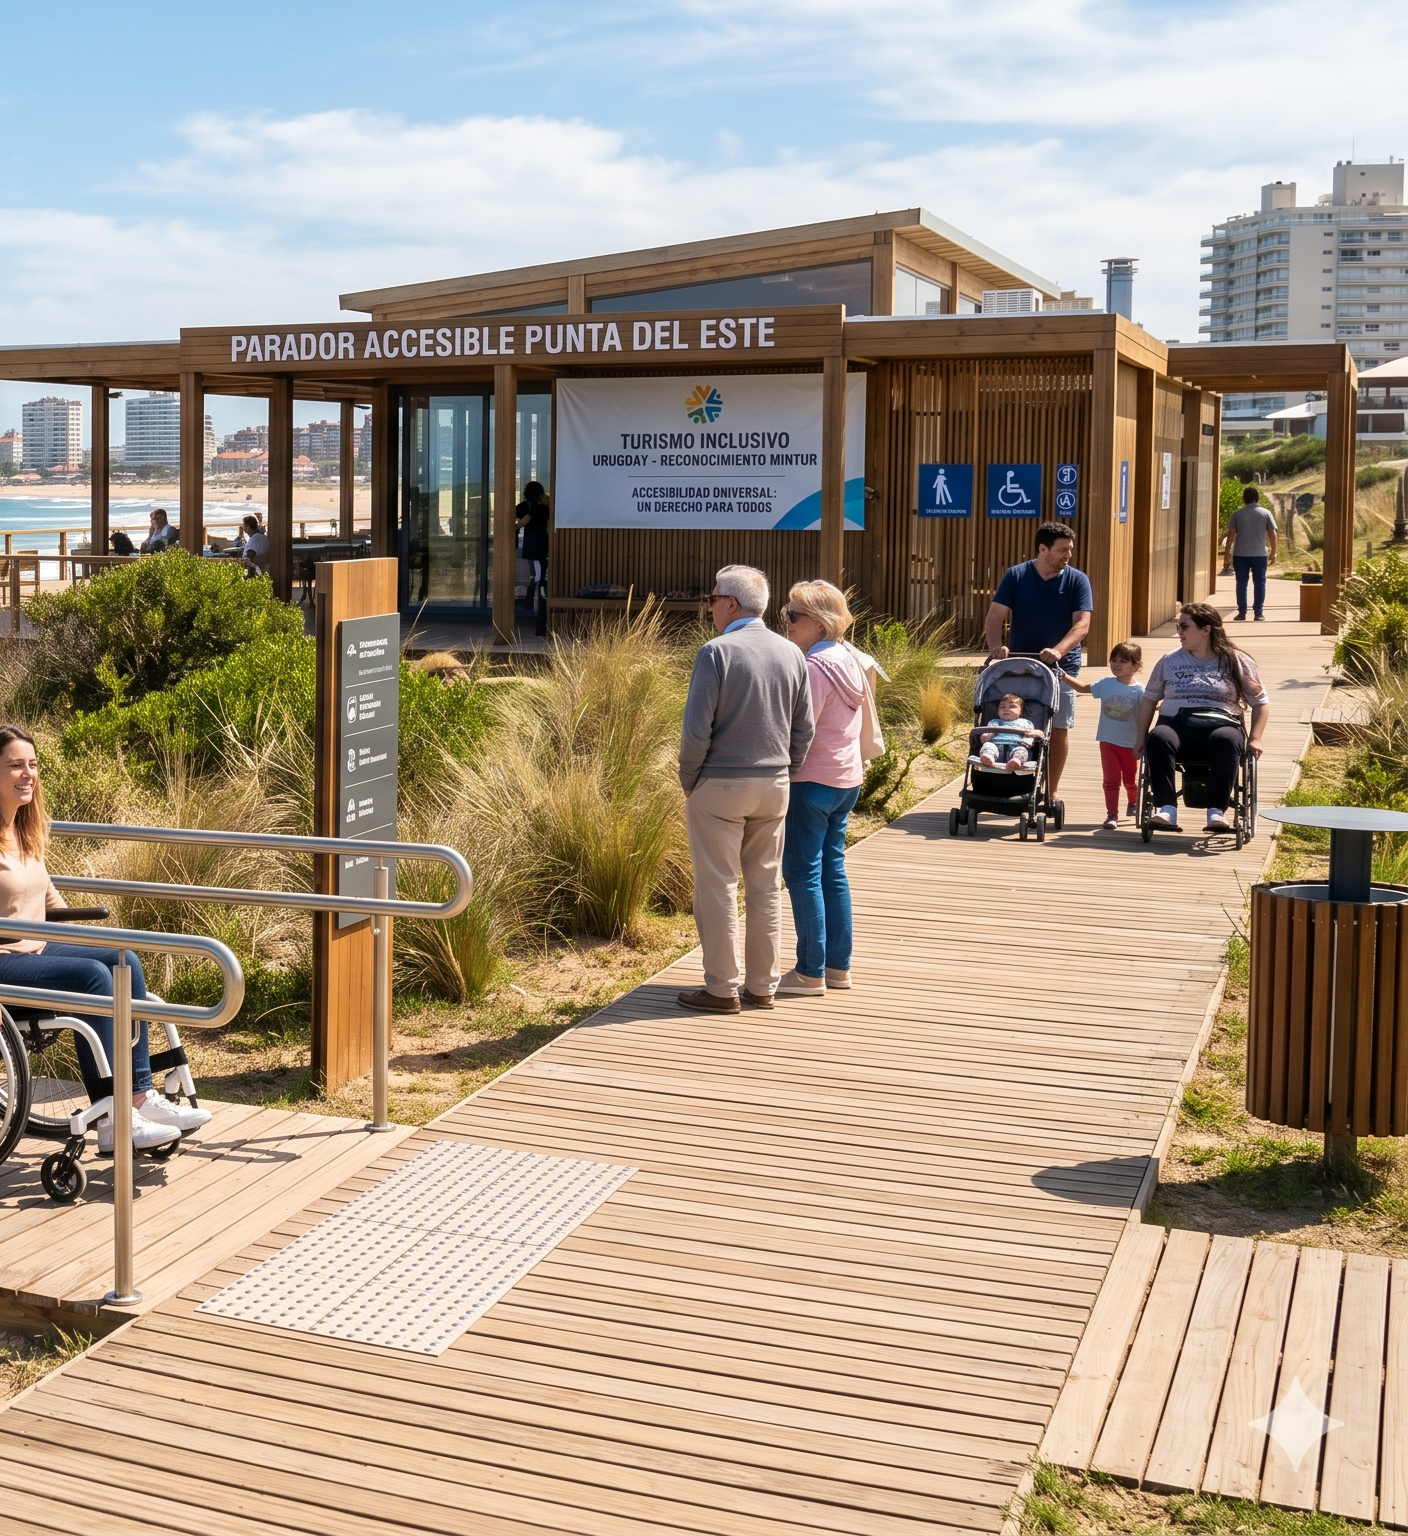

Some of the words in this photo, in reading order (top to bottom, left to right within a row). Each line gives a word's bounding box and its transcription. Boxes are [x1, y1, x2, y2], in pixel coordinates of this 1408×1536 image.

[231, 332, 355, 362] PARADOR
[363, 326, 515, 359] ACCESIBLE
[525, 322, 623, 354] PUNTA
[633, 320, 689, 351] DEL
[700, 317, 775, 349] ESTE
[620, 433, 695, 450] TURISMO
[700, 431, 790, 449] INCLUSIVO
[660, 453, 767, 467] RECONOCIMIENTO
[769, 453, 818, 466] MINTUR
[636, 501, 652, 513] UN
[654, 501, 703, 513] DERECHO
[705, 501, 734, 513] PARA
[736, 501, 773, 513] TODOS
